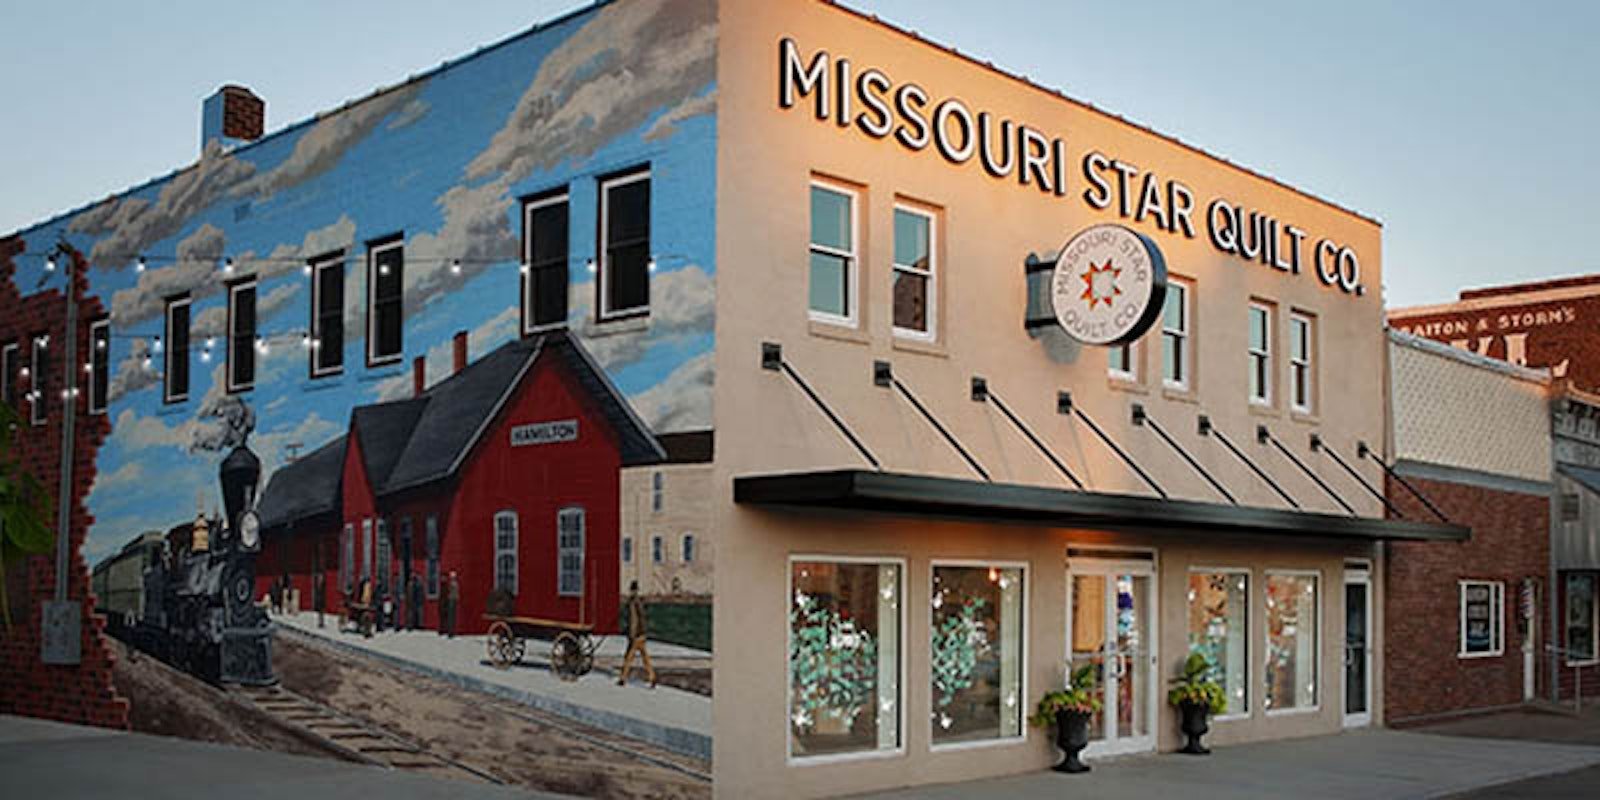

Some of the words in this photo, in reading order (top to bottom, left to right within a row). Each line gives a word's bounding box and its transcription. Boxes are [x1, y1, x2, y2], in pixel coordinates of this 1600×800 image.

[779, 38, 1065, 196] MISSOURI
[1082, 152, 1196, 238] STAR
[1208, 199, 1306, 274] QUILT
[1315, 240, 1367, 296] CO.
[1057, 231, 1117, 295] MISSOURI
[1119, 238, 1148, 283] STAR
[1065, 310, 1106, 337] QUILT
[514, 423, 575, 441] HAMILTON
